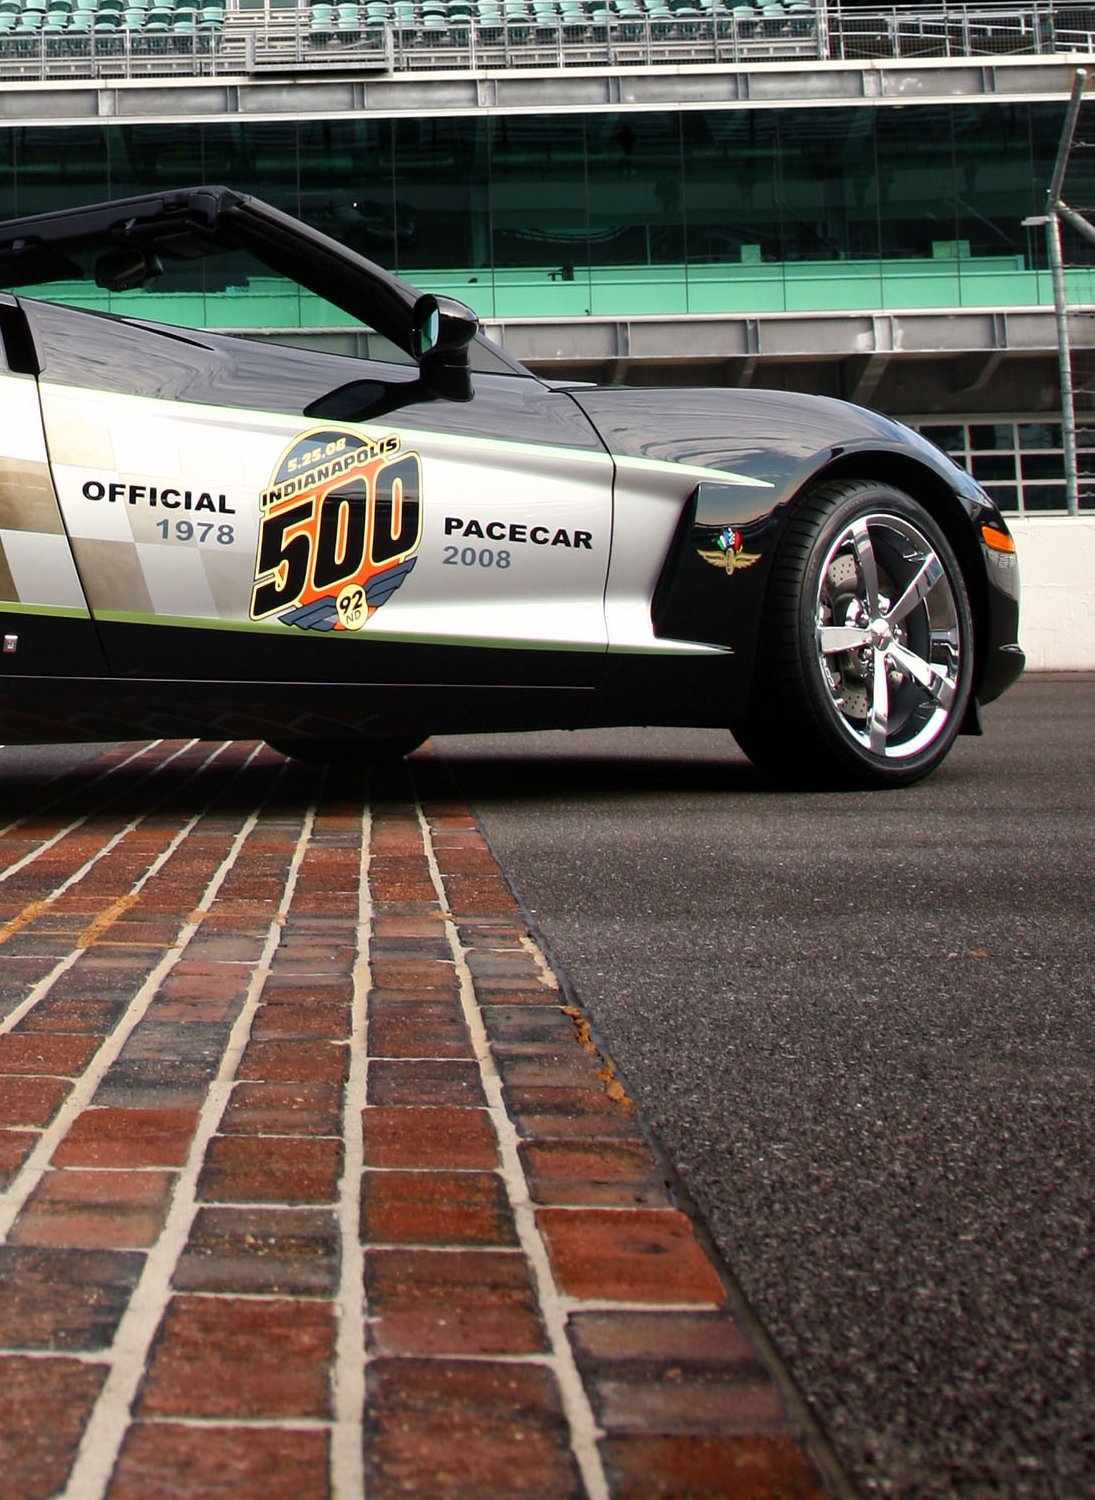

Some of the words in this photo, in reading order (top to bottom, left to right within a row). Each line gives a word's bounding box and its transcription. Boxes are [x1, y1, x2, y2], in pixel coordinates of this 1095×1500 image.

[261, 436, 398, 507] INDIANAPOLIS
[286, 437, 348, 473] 5.25.08
[82, 481, 237, 515] OFFICIAL
[155, 518, 236, 545] 1978
[251, 453, 421, 619] 500
[444, 517, 594, 550] PACECAR
[442, 546, 513, 569] 2008
[339, 589, 363, 616] 92
